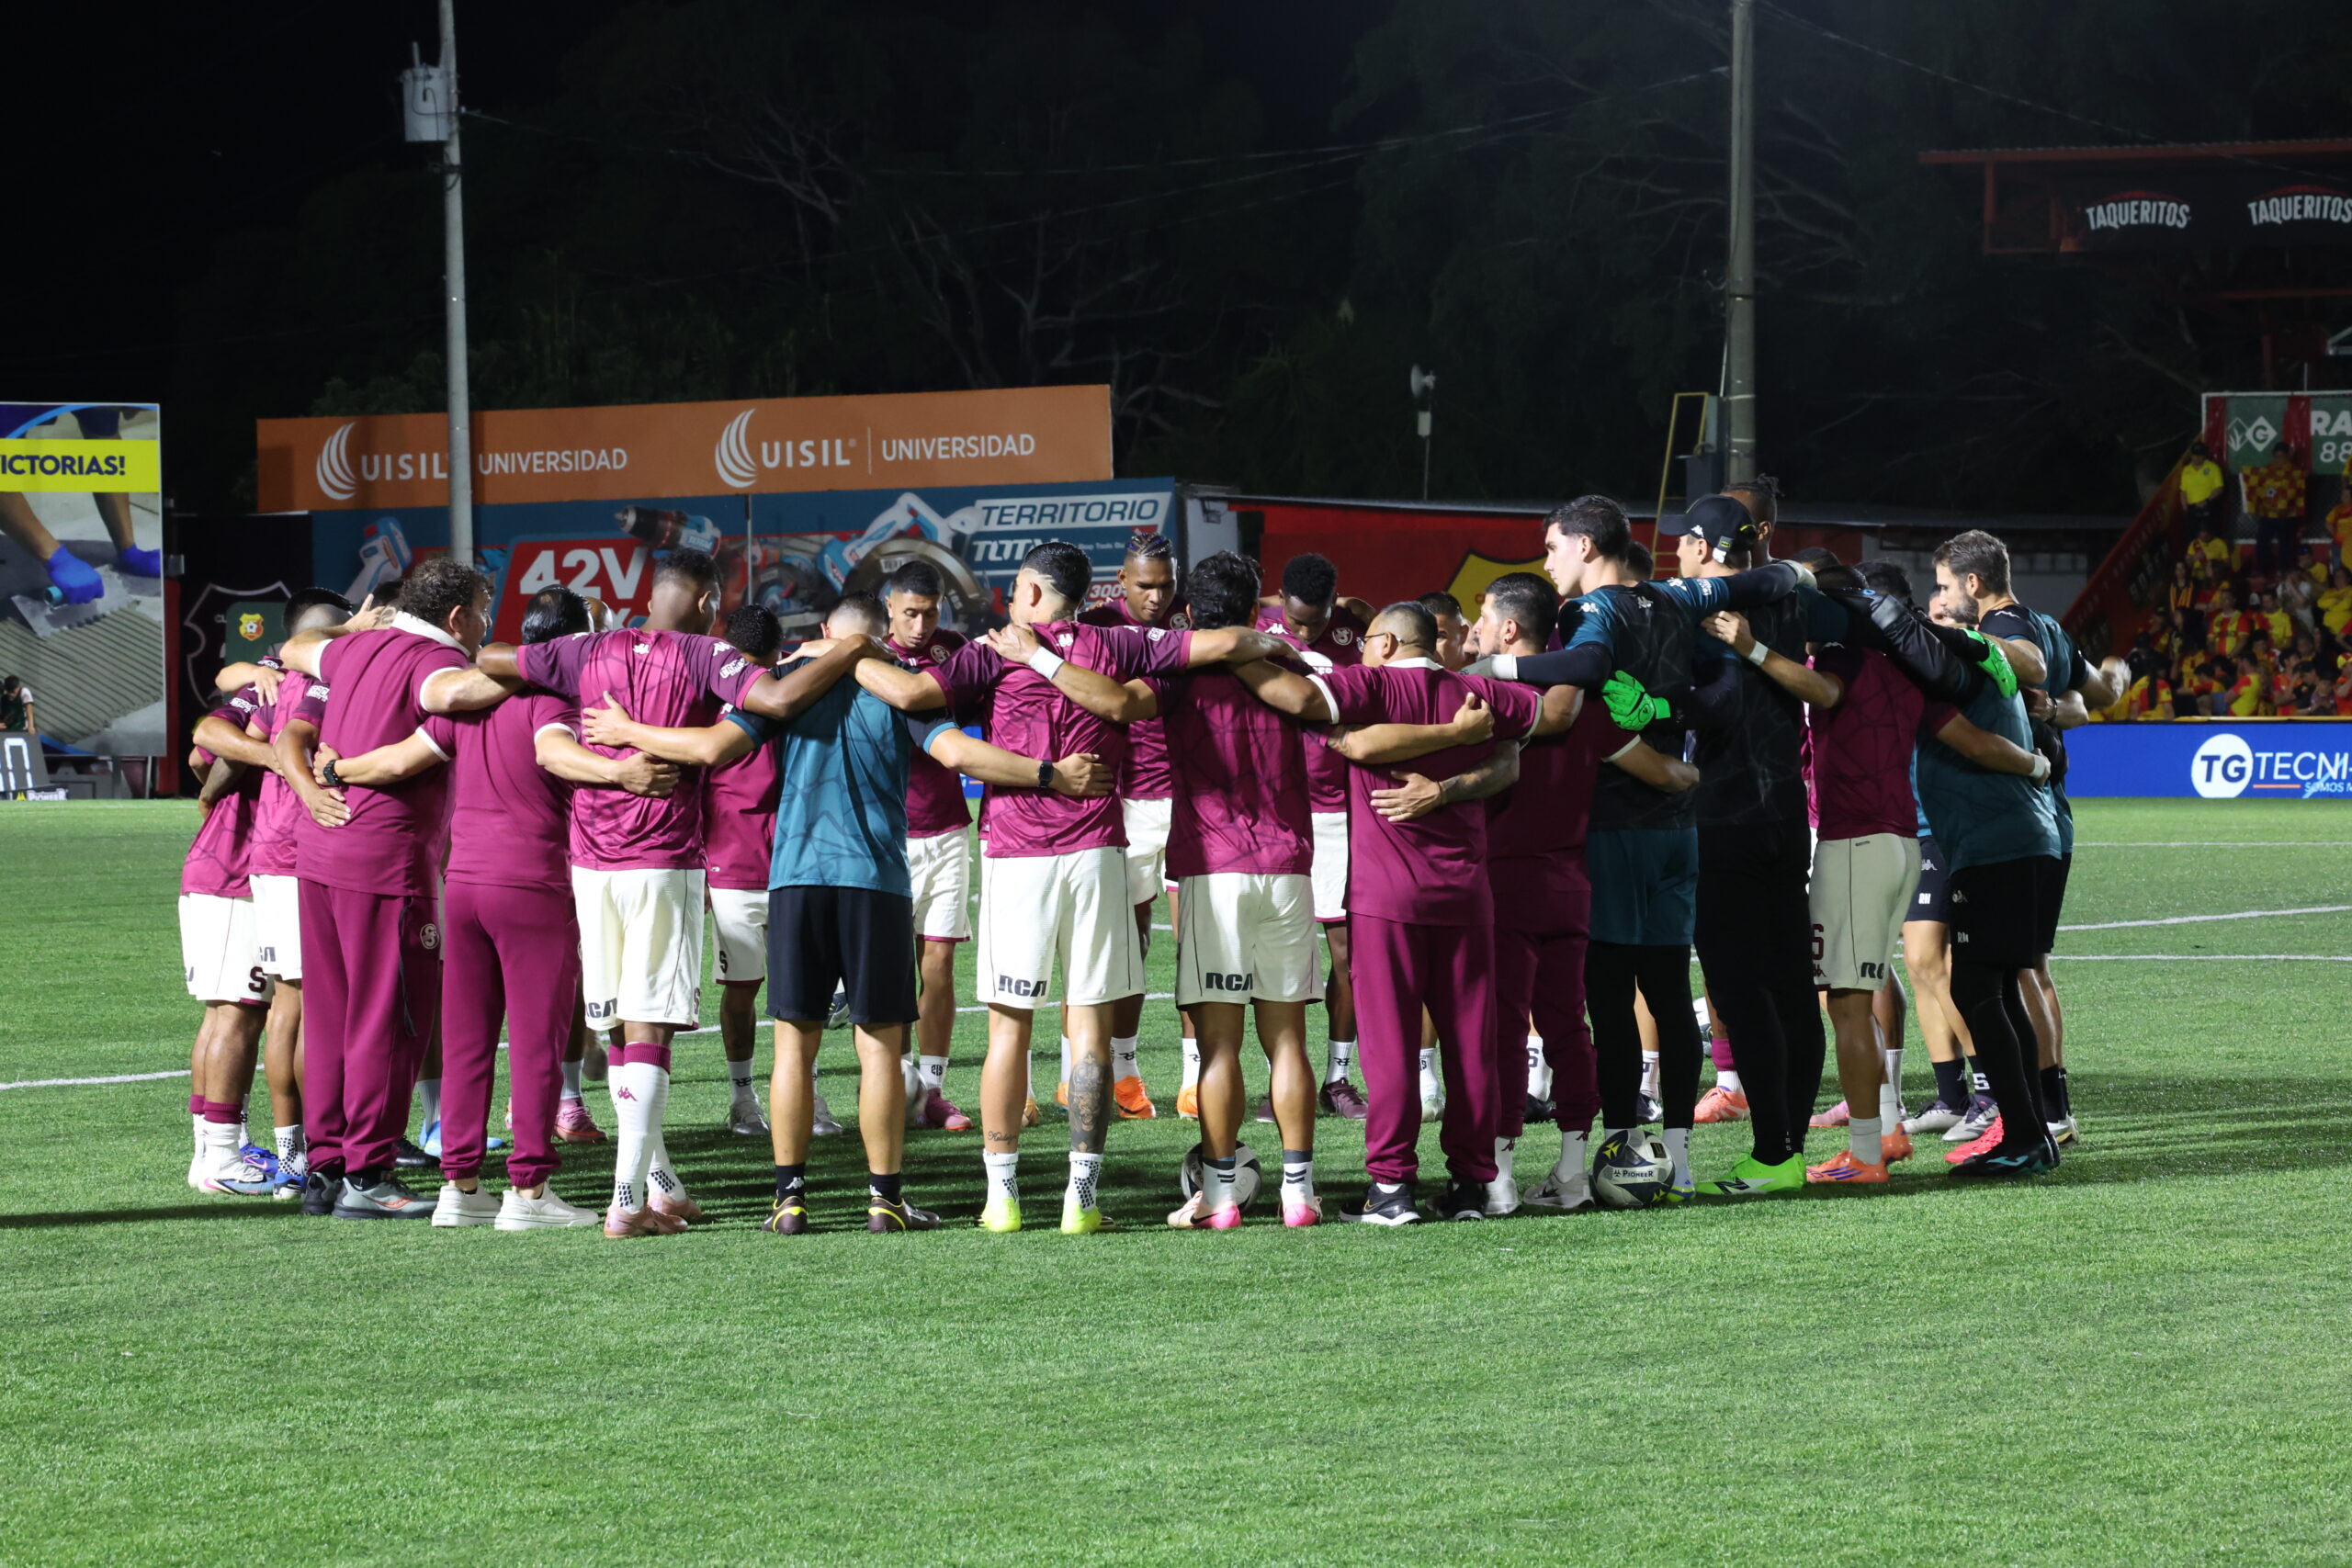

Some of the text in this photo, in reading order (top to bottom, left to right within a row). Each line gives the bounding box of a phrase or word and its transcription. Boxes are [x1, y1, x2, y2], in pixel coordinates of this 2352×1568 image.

[2086, 199, 2190, 230] TAQUERITOS
[0, 454, 126, 476] ICTORIAS!
[361, 448, 628, 480] UISIL UNIVERSIDAD
[762, 434, 1035, 468] UISIL UNIVERSIDAD
[982, 499, 1159, 526] TERRITORIO
[520, 547, 647, 600] 42V
[2200, 754, 2247, 784] TG
[2303, 782, 2345, 793] SOMOS
[248, 965, 266, 994] S
[998, 974, 1047, 998] RCA
[1205, 972, 1253, 991] RCA
[586, 998, 617, 1019] CA
